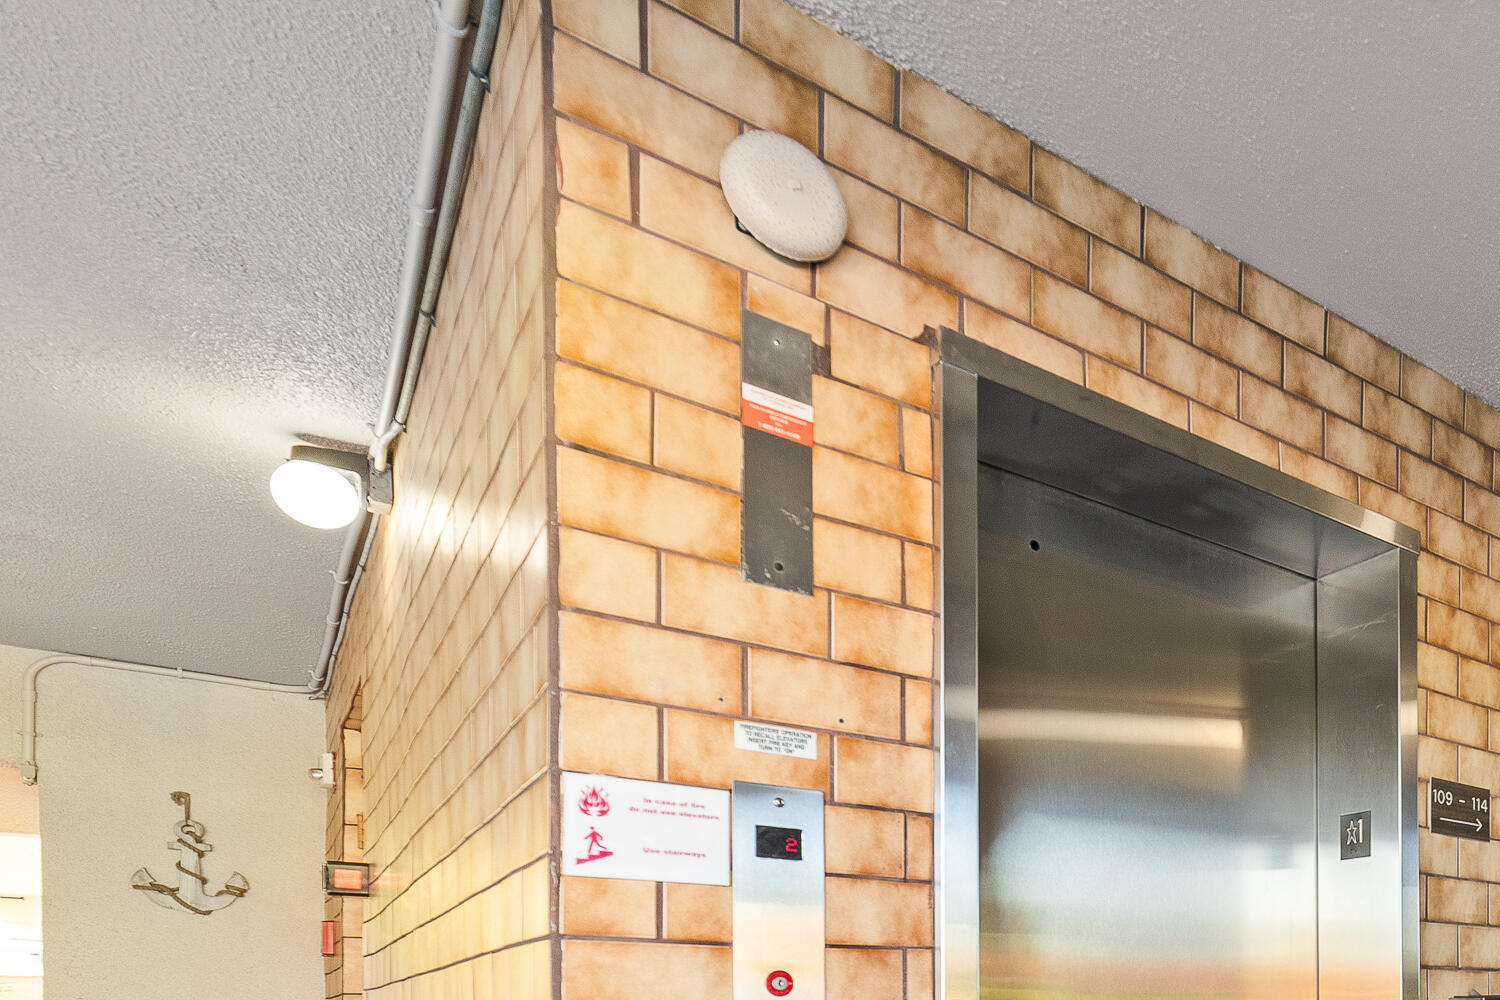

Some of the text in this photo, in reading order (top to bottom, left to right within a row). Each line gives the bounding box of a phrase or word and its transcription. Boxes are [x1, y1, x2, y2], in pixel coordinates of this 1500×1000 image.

[754, 731, 775, 740] RECALL
[777, 735, 808, 745] ELEVATORS
[781, 729, 812, 739] OPERATION
[759, 743, 773, 751] TURN
[1433, 788, 1453, 806] 109
[1472, 796, 1489, 813] 114
[679, 812, 719, 820] elevators
[785, 837, 798, 853] 2
[664, 849, 707, 858] stairways
